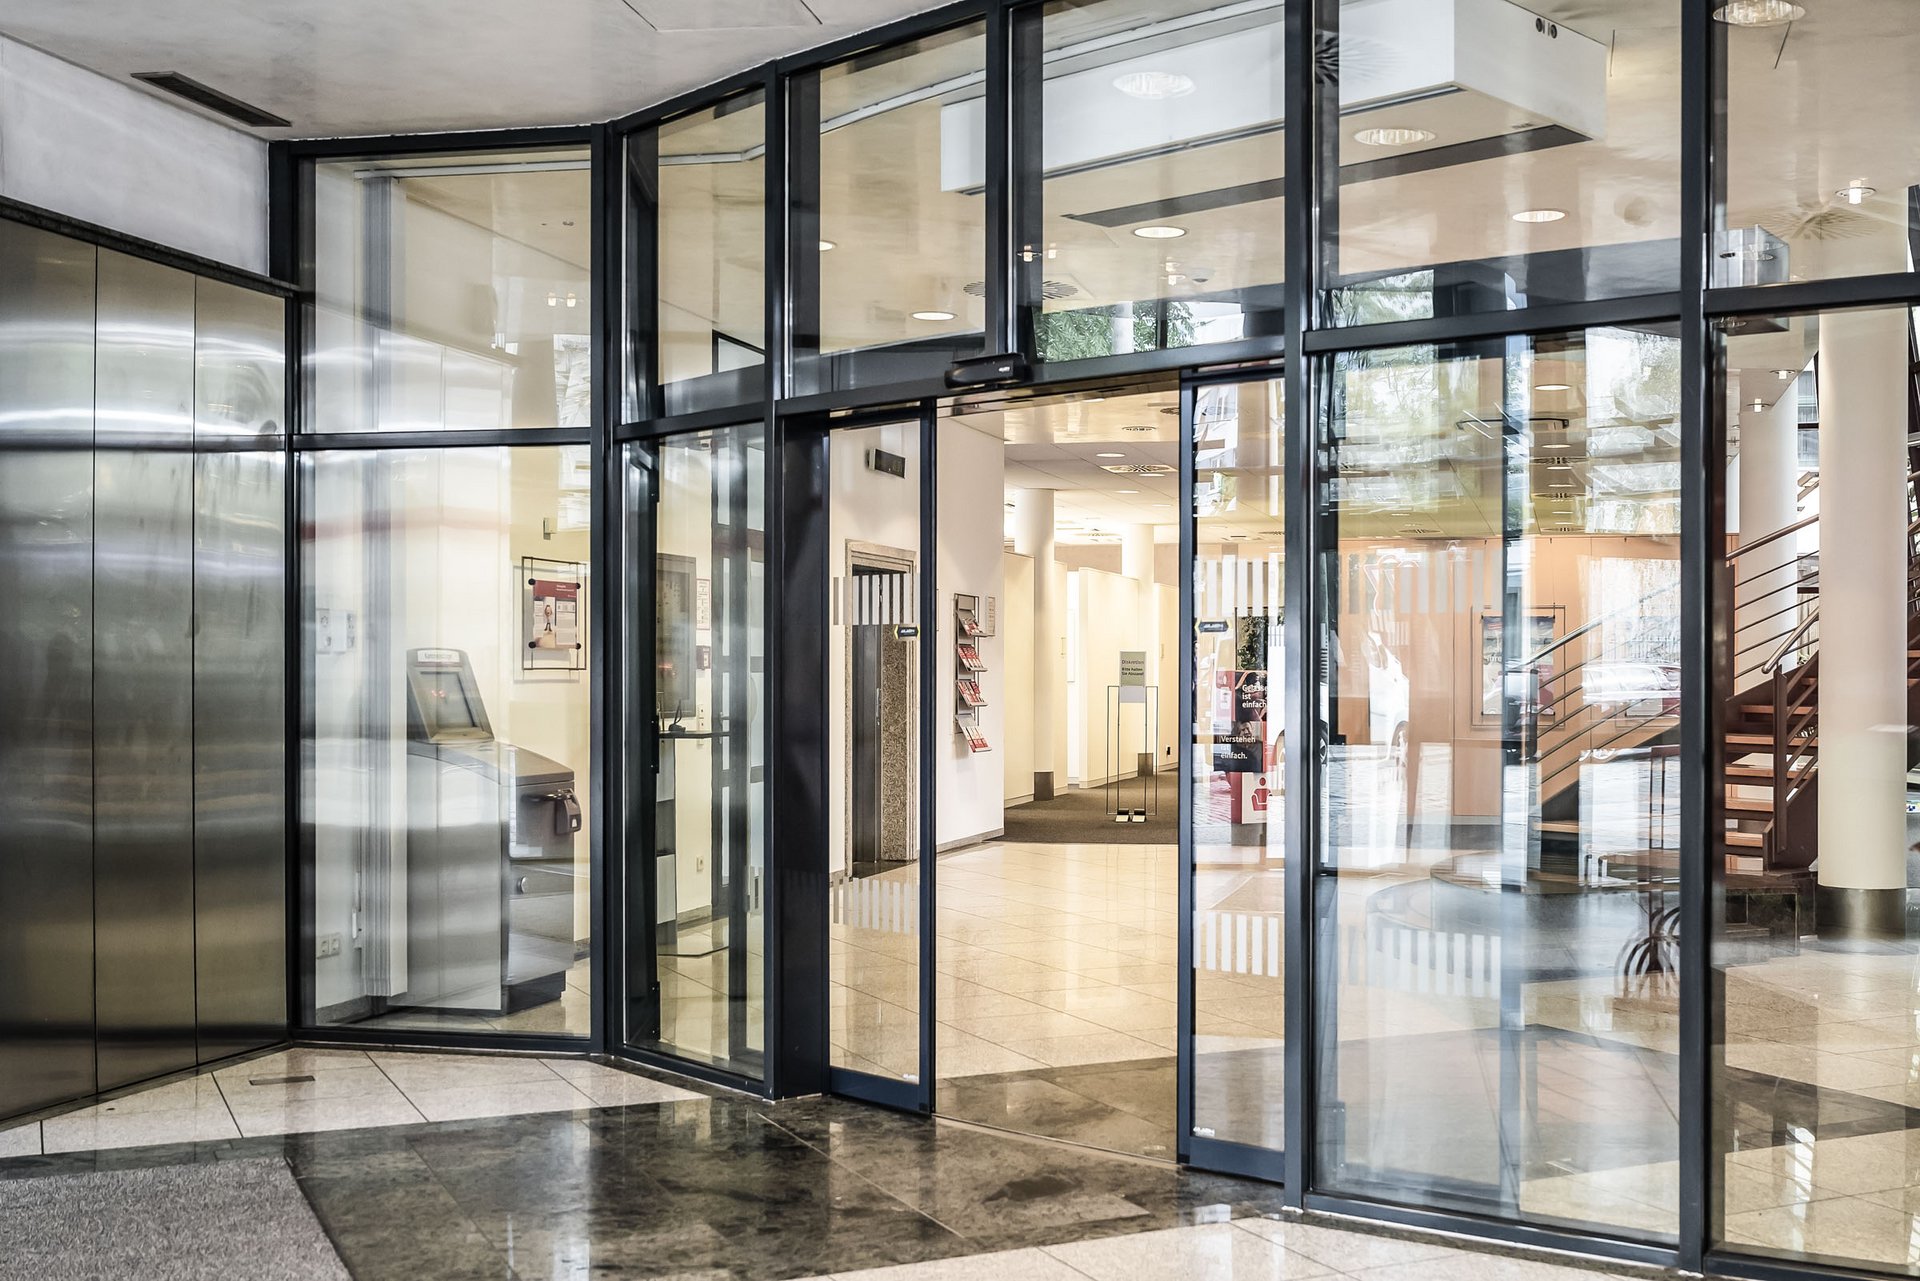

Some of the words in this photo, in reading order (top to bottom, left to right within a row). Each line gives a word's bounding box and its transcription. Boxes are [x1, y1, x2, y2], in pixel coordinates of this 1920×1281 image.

[1242, 692, 1251, 700] ist
[1220, 735, 1256, 743] Verstehen
[1220, 751, 1248, 759] einfach.
